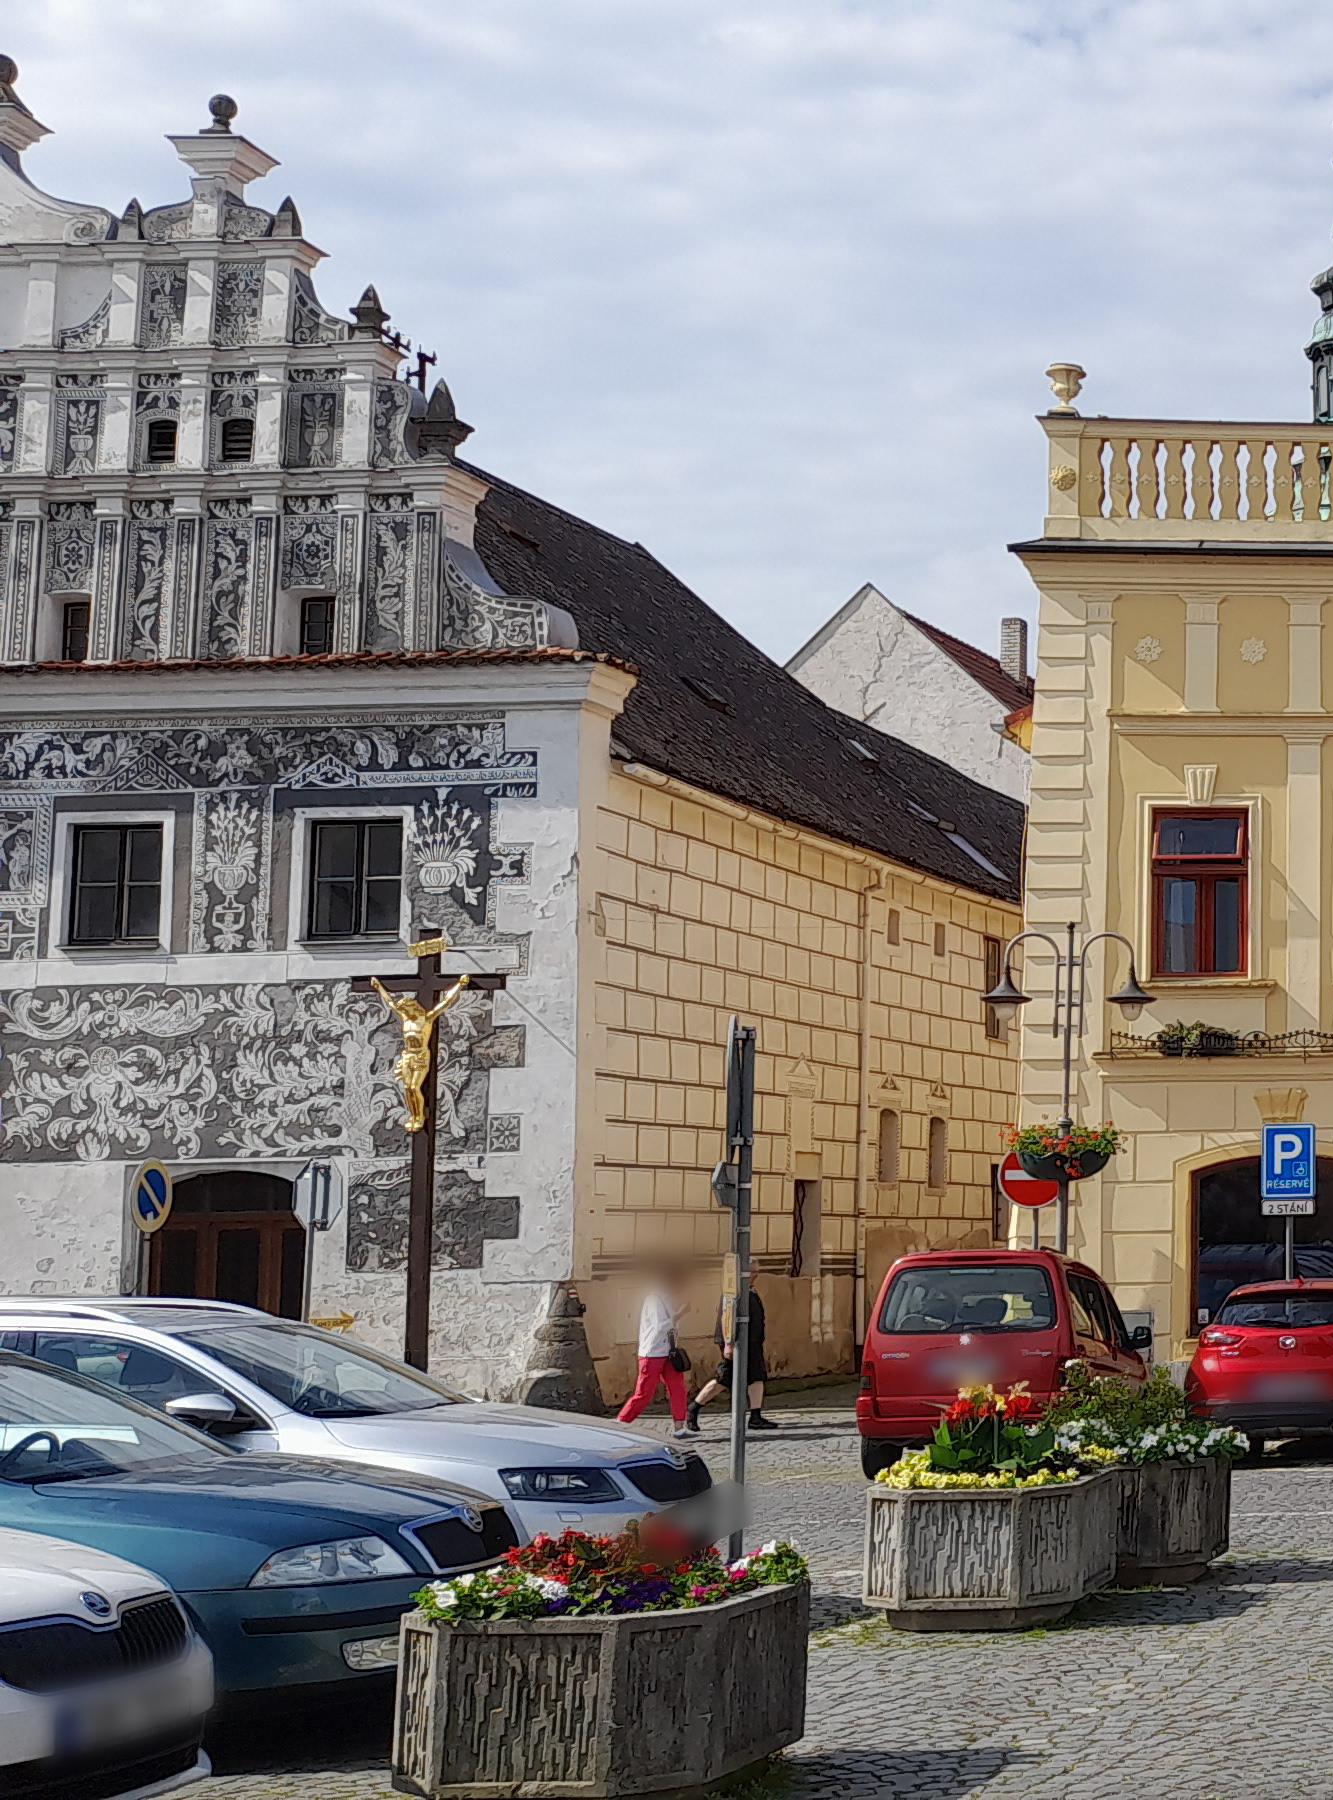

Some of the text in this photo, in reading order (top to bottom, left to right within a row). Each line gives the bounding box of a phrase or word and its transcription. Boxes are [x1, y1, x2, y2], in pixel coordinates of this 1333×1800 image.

[1274, 1134, 1303, 1175] P
[1269, 1201, 1308, 1214] 2 STÁNÍ
